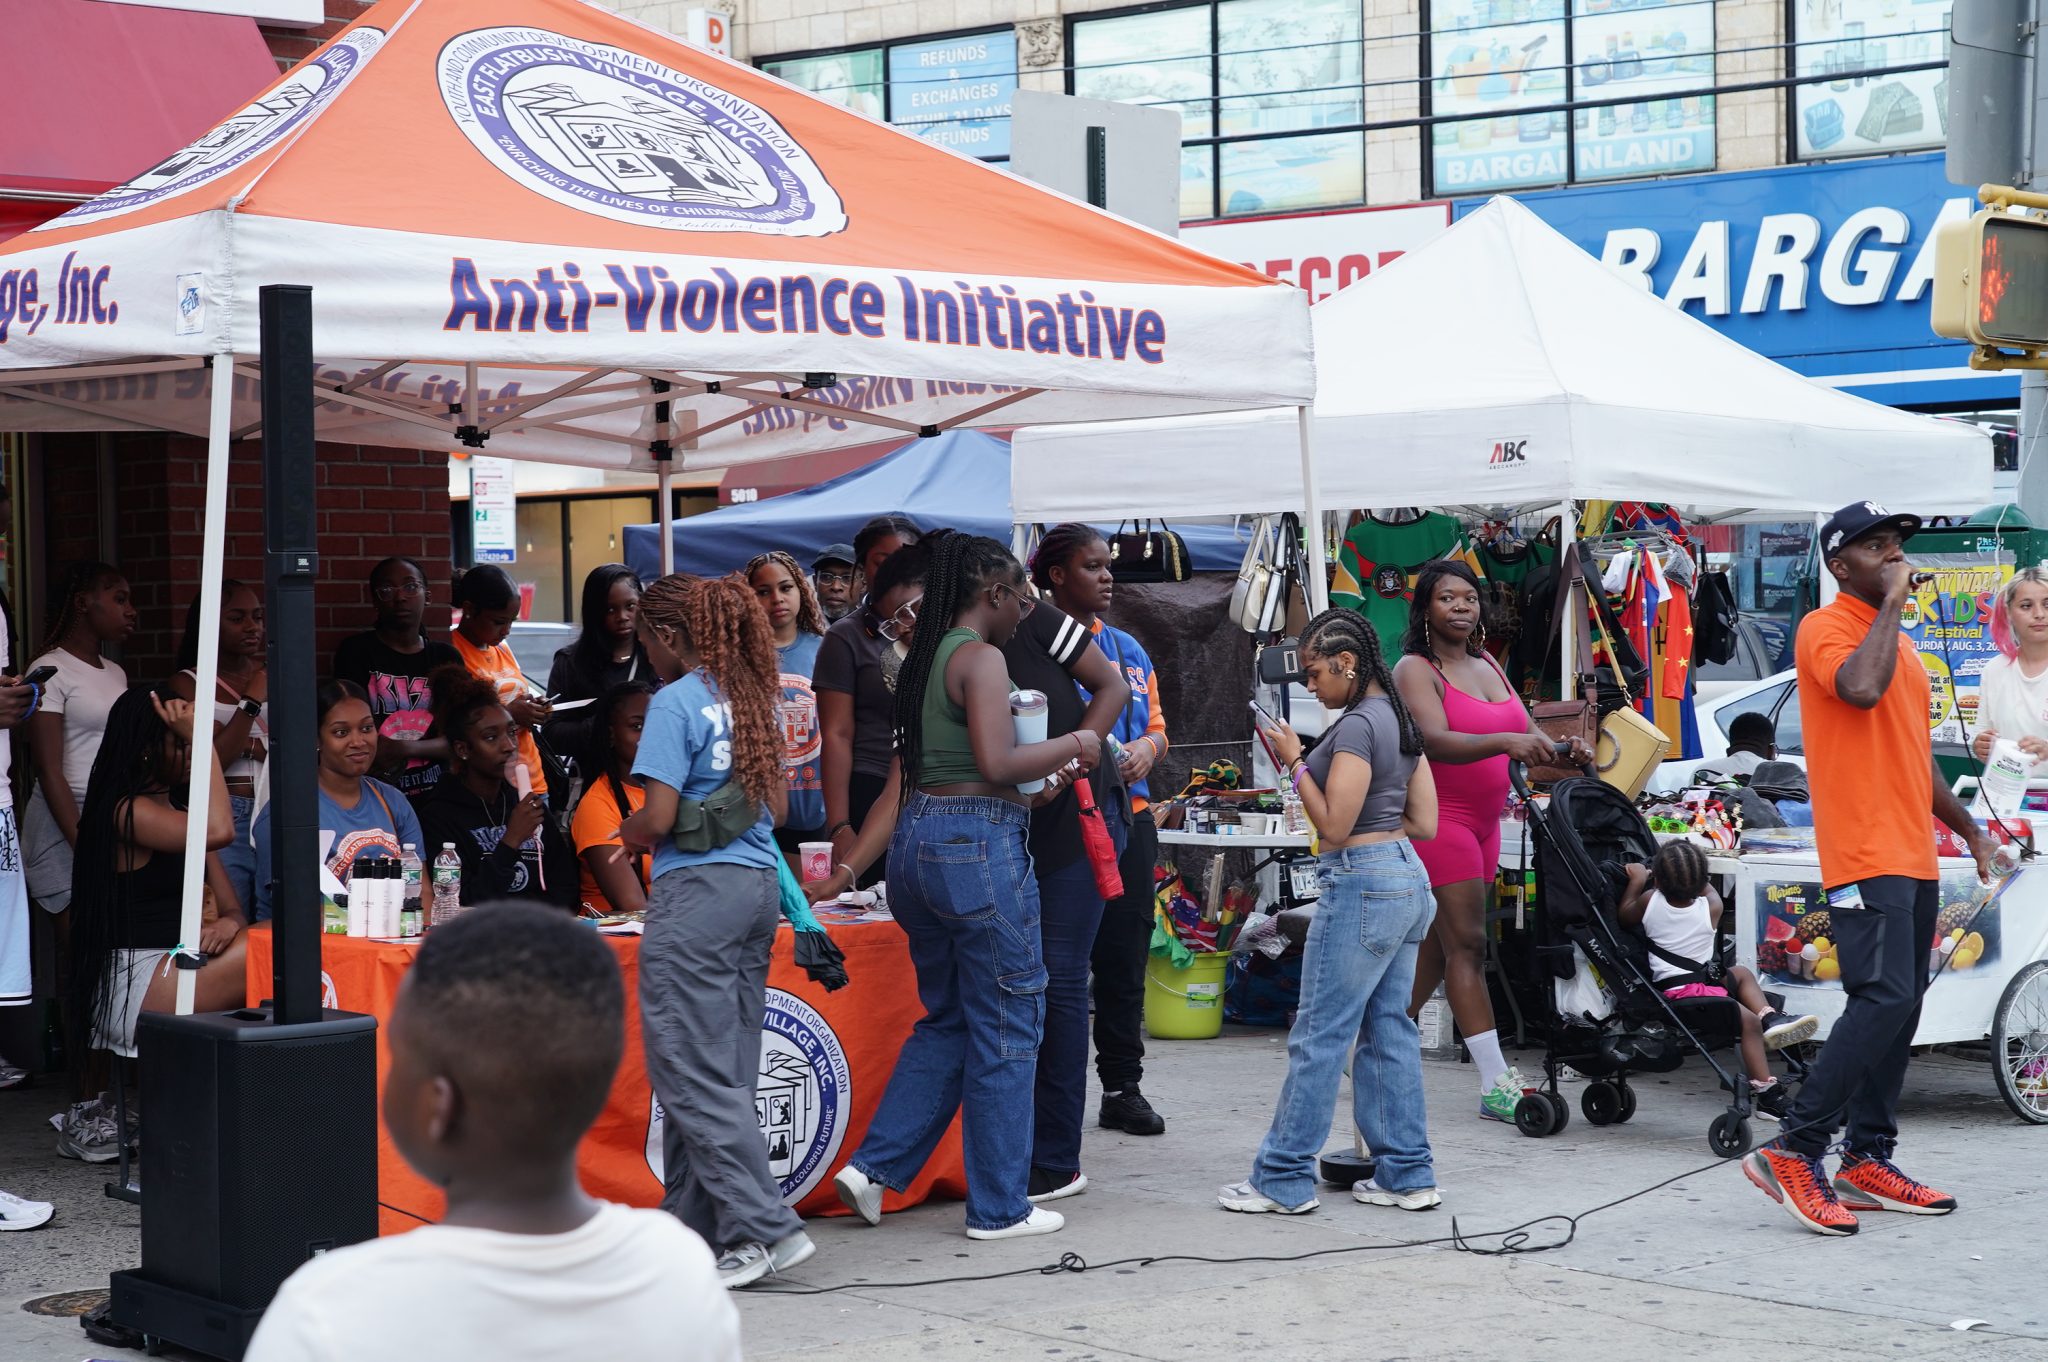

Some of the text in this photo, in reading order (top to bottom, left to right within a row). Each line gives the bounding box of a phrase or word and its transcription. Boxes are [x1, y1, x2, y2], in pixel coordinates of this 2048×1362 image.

[708, 17, 724, 44] D
[920, 44, 988, 67] REFUNDS
[446, 31, 801, 160] YOUTH AND COMMUNITY DEVELOPMENT ORGANIZATION
[472, 48, 764, 156] EAST FLATBUSH VILLAGE, INC.
[911, 83, 998, 108] EXCHANGES
[569, 183, 600, 200] THE
[601, 194, 645, 211] LIVES
[648, 204, 670, 214] OF
[54, 250, 119, 325] Inc.
[443, 257, 1166, 365] Anti-Violence Initiative
[1489, 440, 1527, 463] ABC
[1901, 611, 1918, 620] EVENT
[1903, 603, 1916, 612] FREE
[1916, 591, 1994, 624] KIDS
[1913, 640, 1951, 652] TURDAY,
[1951, 641, 1975, 652] AUG.
[1976, 641, 1985, 653] 3,
[1923, 625, 1984, 639] Festival
[368, 670, 431, 714] KIS
[1942, 676, 1950, 684] at
[806, 1013, 848, 1095] ORGANIZATION
[814, 1054, 833, 1092] INC.
[788, 1181, 796, 1190] A
[795, 1144, 825, 1184] COLORFUL
